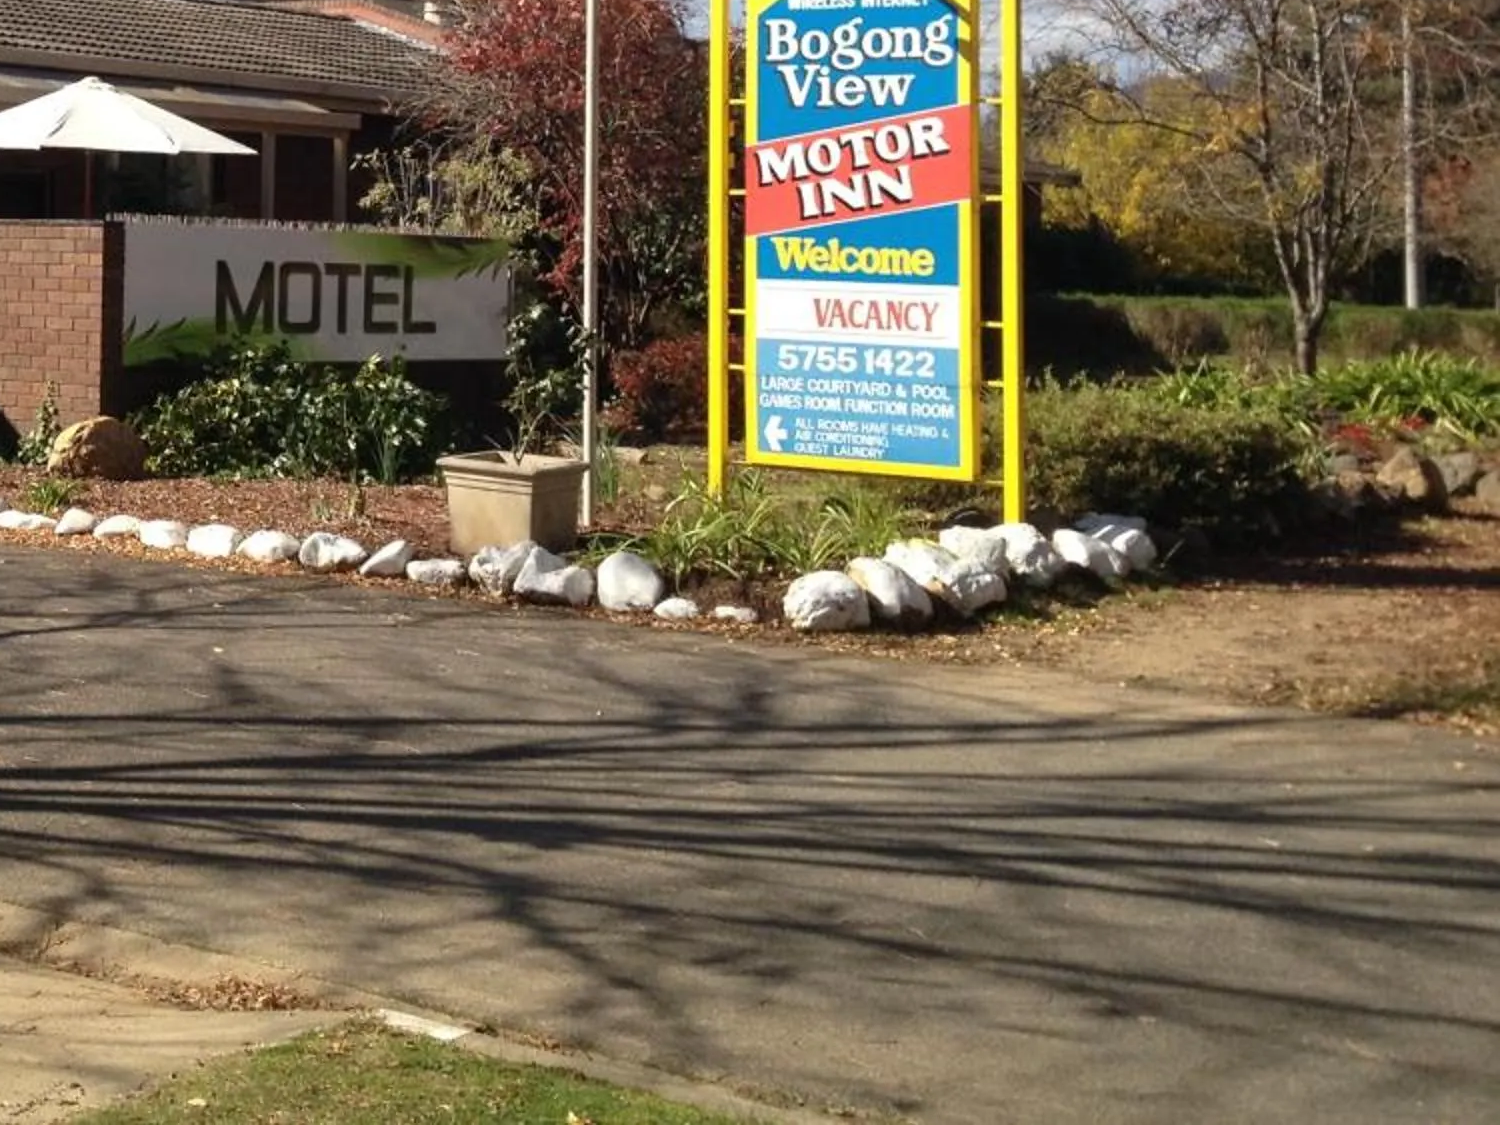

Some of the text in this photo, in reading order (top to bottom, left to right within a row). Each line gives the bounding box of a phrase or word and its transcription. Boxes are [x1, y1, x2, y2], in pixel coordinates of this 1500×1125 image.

[765, 12, 954, 70] Bogong
[778, 64, 916, 108] View
[755, 116, 951, 186] MOTOR
[797, 165, 914, 219] INN
[770, 236, 936, 276] Welcome
[215, 260, 437, 335] MOTEL
[813, 298, 940, 332] VACANCY
[778, 344, 935, 378] 5755 1422
[760, 376, 951, 401] LARGE COURTYARD & POOL
[759, 394, 956, 419] GAMES ROOM FUNCTION ROOM
[794, 429, 812, 441] AIR
[795, 418, 815, 430] ALL
[817, 419, 859, 432] ROOMS
[861, 422, 888, 436] HAVE
[892, 424, 938, 439] HEATING
[794, 442, 885, 459] GUEST LAUNDRY
